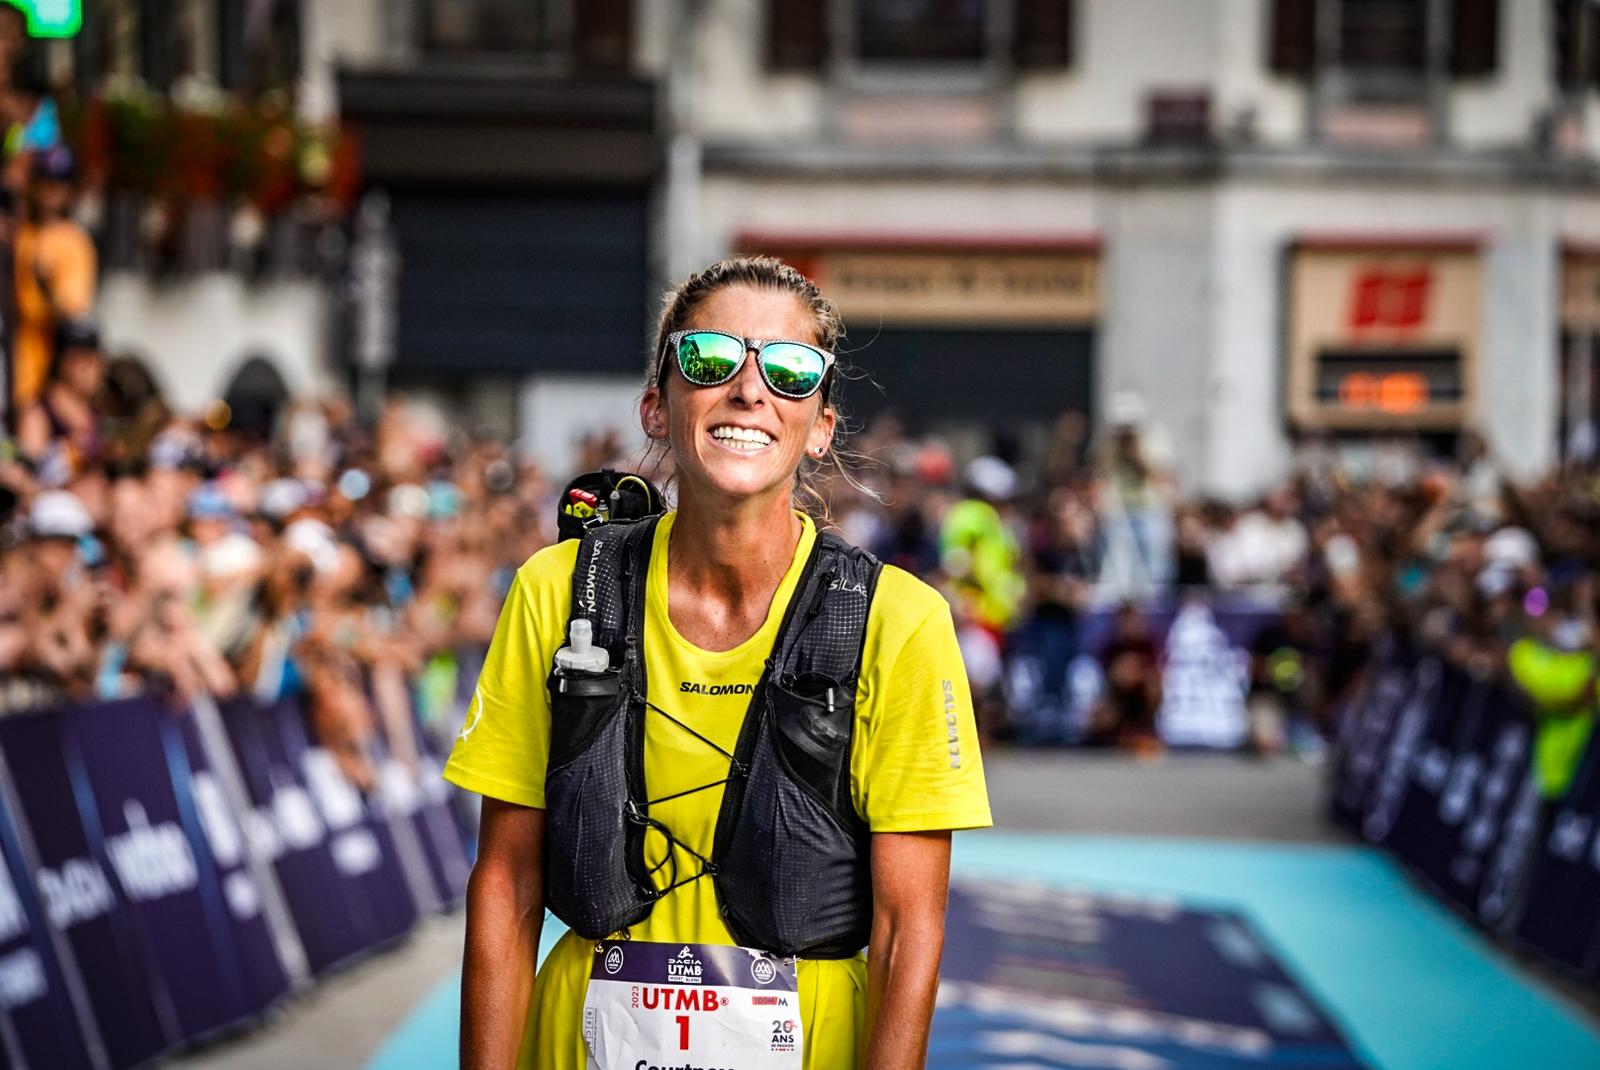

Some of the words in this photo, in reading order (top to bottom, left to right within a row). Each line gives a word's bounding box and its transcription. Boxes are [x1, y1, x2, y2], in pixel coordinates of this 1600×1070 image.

[586, 540, 604, 613] SALOMON
[680, 682, 757, 695] SALOMON
[942, 680, 961, 769] SALOMON
[675, 1015, 690, 1050] 1
[771, 1034, 794, 1043] ANS
[772, 1019, 793, 1034] 20
